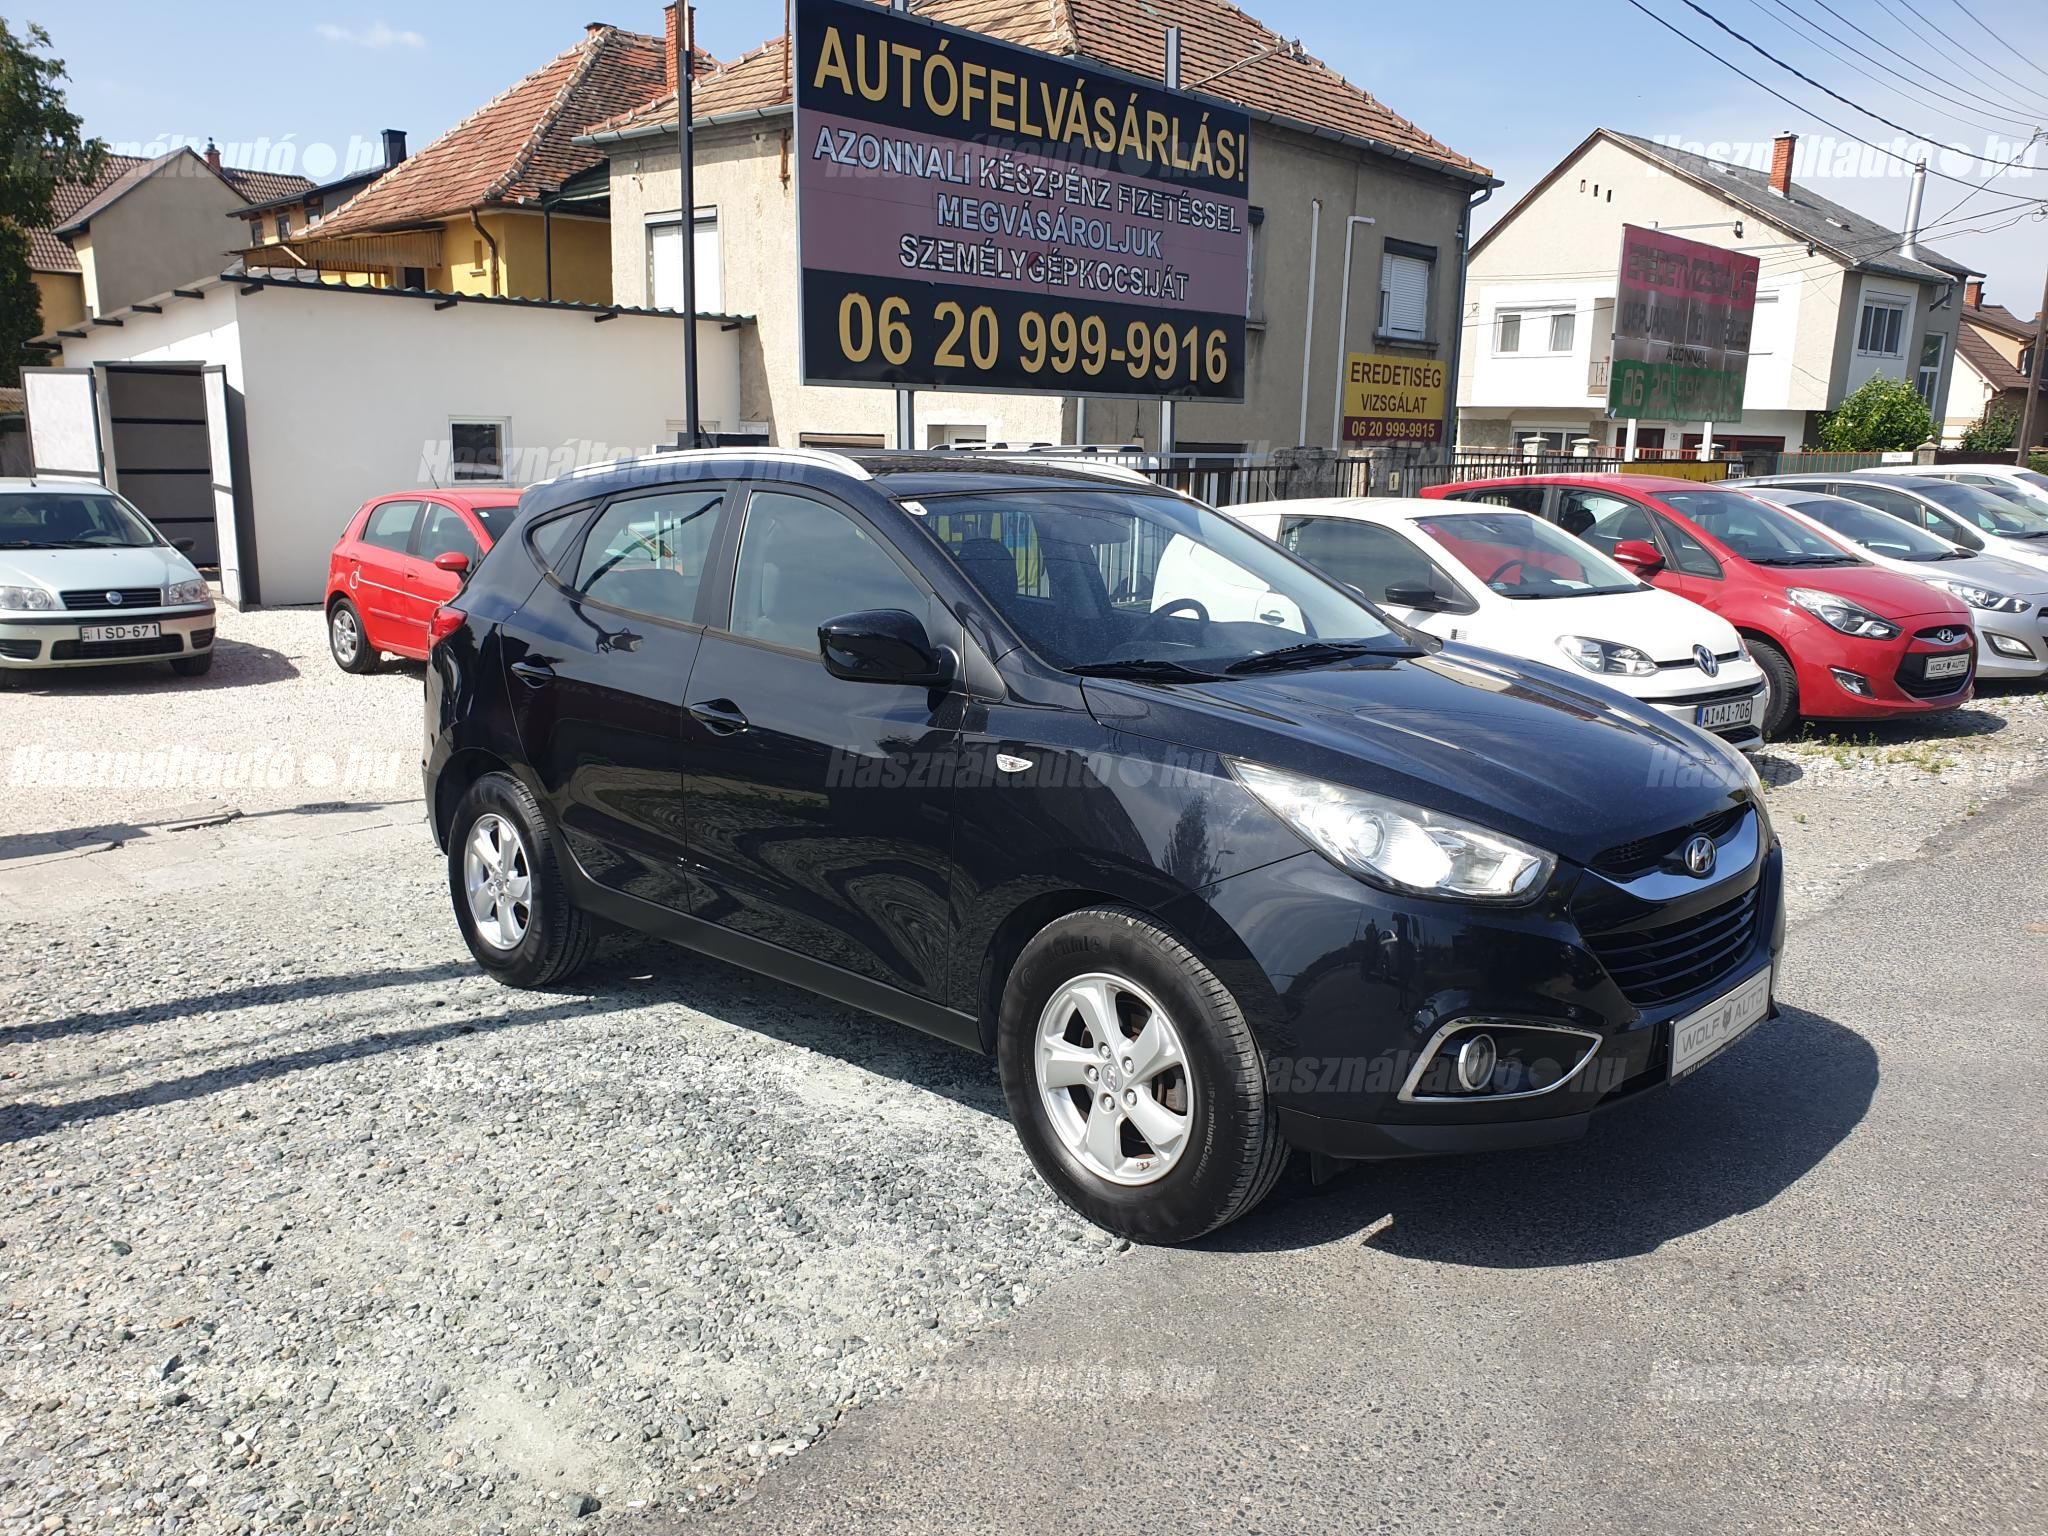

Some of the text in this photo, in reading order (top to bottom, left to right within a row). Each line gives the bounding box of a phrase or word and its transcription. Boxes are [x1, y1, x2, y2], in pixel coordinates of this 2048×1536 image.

[813, 26, 1246, 182] AUTÓFELVÁSÁRLÁS!
[813, 127, 1242, 234] AZONNALI KÉSZPÉNZ FIZETÉSSEL
[936, 194, 1163, 259] MEGVÁSÁROLJUK
[898, 234, 1189, 301] SZEMÉLYGÉPKOCSIJÁT
[838, 292, 1228, 383] 06 20 999-9916
[1350, 361, 1441, 389] EREDETISÉG
[1361, 391, 1428, 414] VIZSGÁLAT
[1351, 420, 1435, 438] 06 20 999-9915
[1681, 1017, 1720, 1054] WOLF
[1733, 987, 1763, 1021] AUTO
